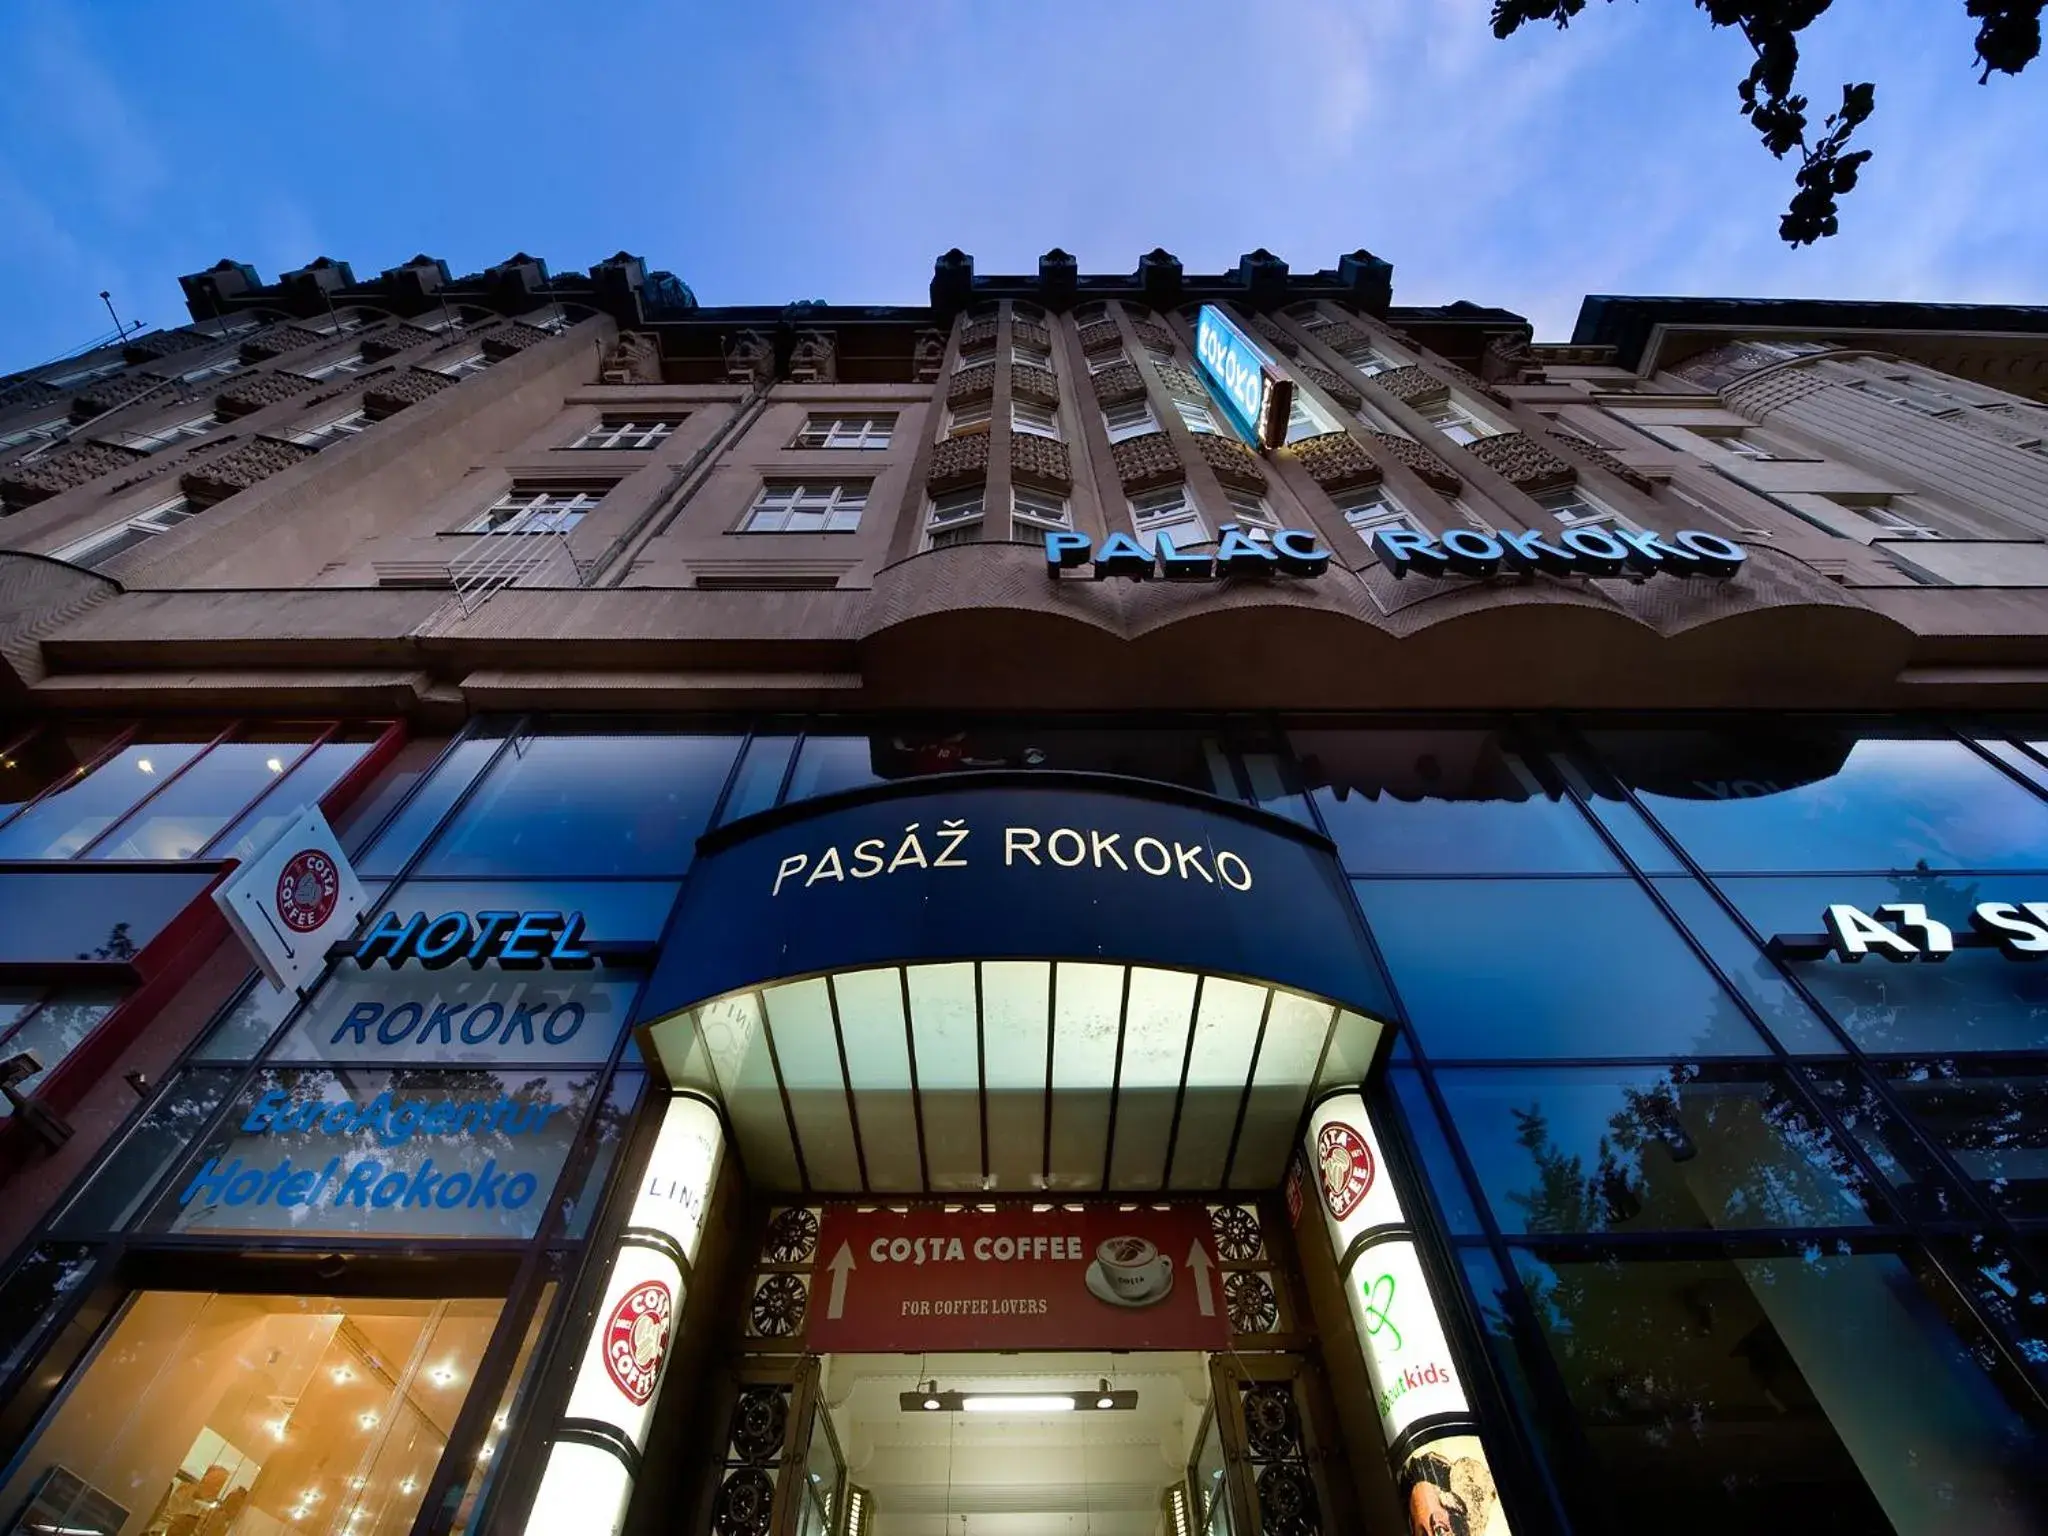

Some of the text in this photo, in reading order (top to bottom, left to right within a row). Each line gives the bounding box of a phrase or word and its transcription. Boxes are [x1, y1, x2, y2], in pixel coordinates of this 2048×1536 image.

[1200, 321, 1259, 416] ROKOKO
[1045, 524, 1748, 572] PALÁC ROKOKO
[772, 819, 1252, 897] PASÁŽ ROKOKO
[282, 857, 333, 925] COSTA COFFEE
[355, 911, 592, 960] HOTEL
[330, 1002, 586, 1045] ROKOKO
[240, 1089, 565, 1148] EuroAgentur
[178, 1156, 538, 1211] Hotel Rokoko
[870, 1236, 1083, 1266] COSTA COFFEE
[901, 1299, 1048, 1316] FOR COFFEE LOVERS
